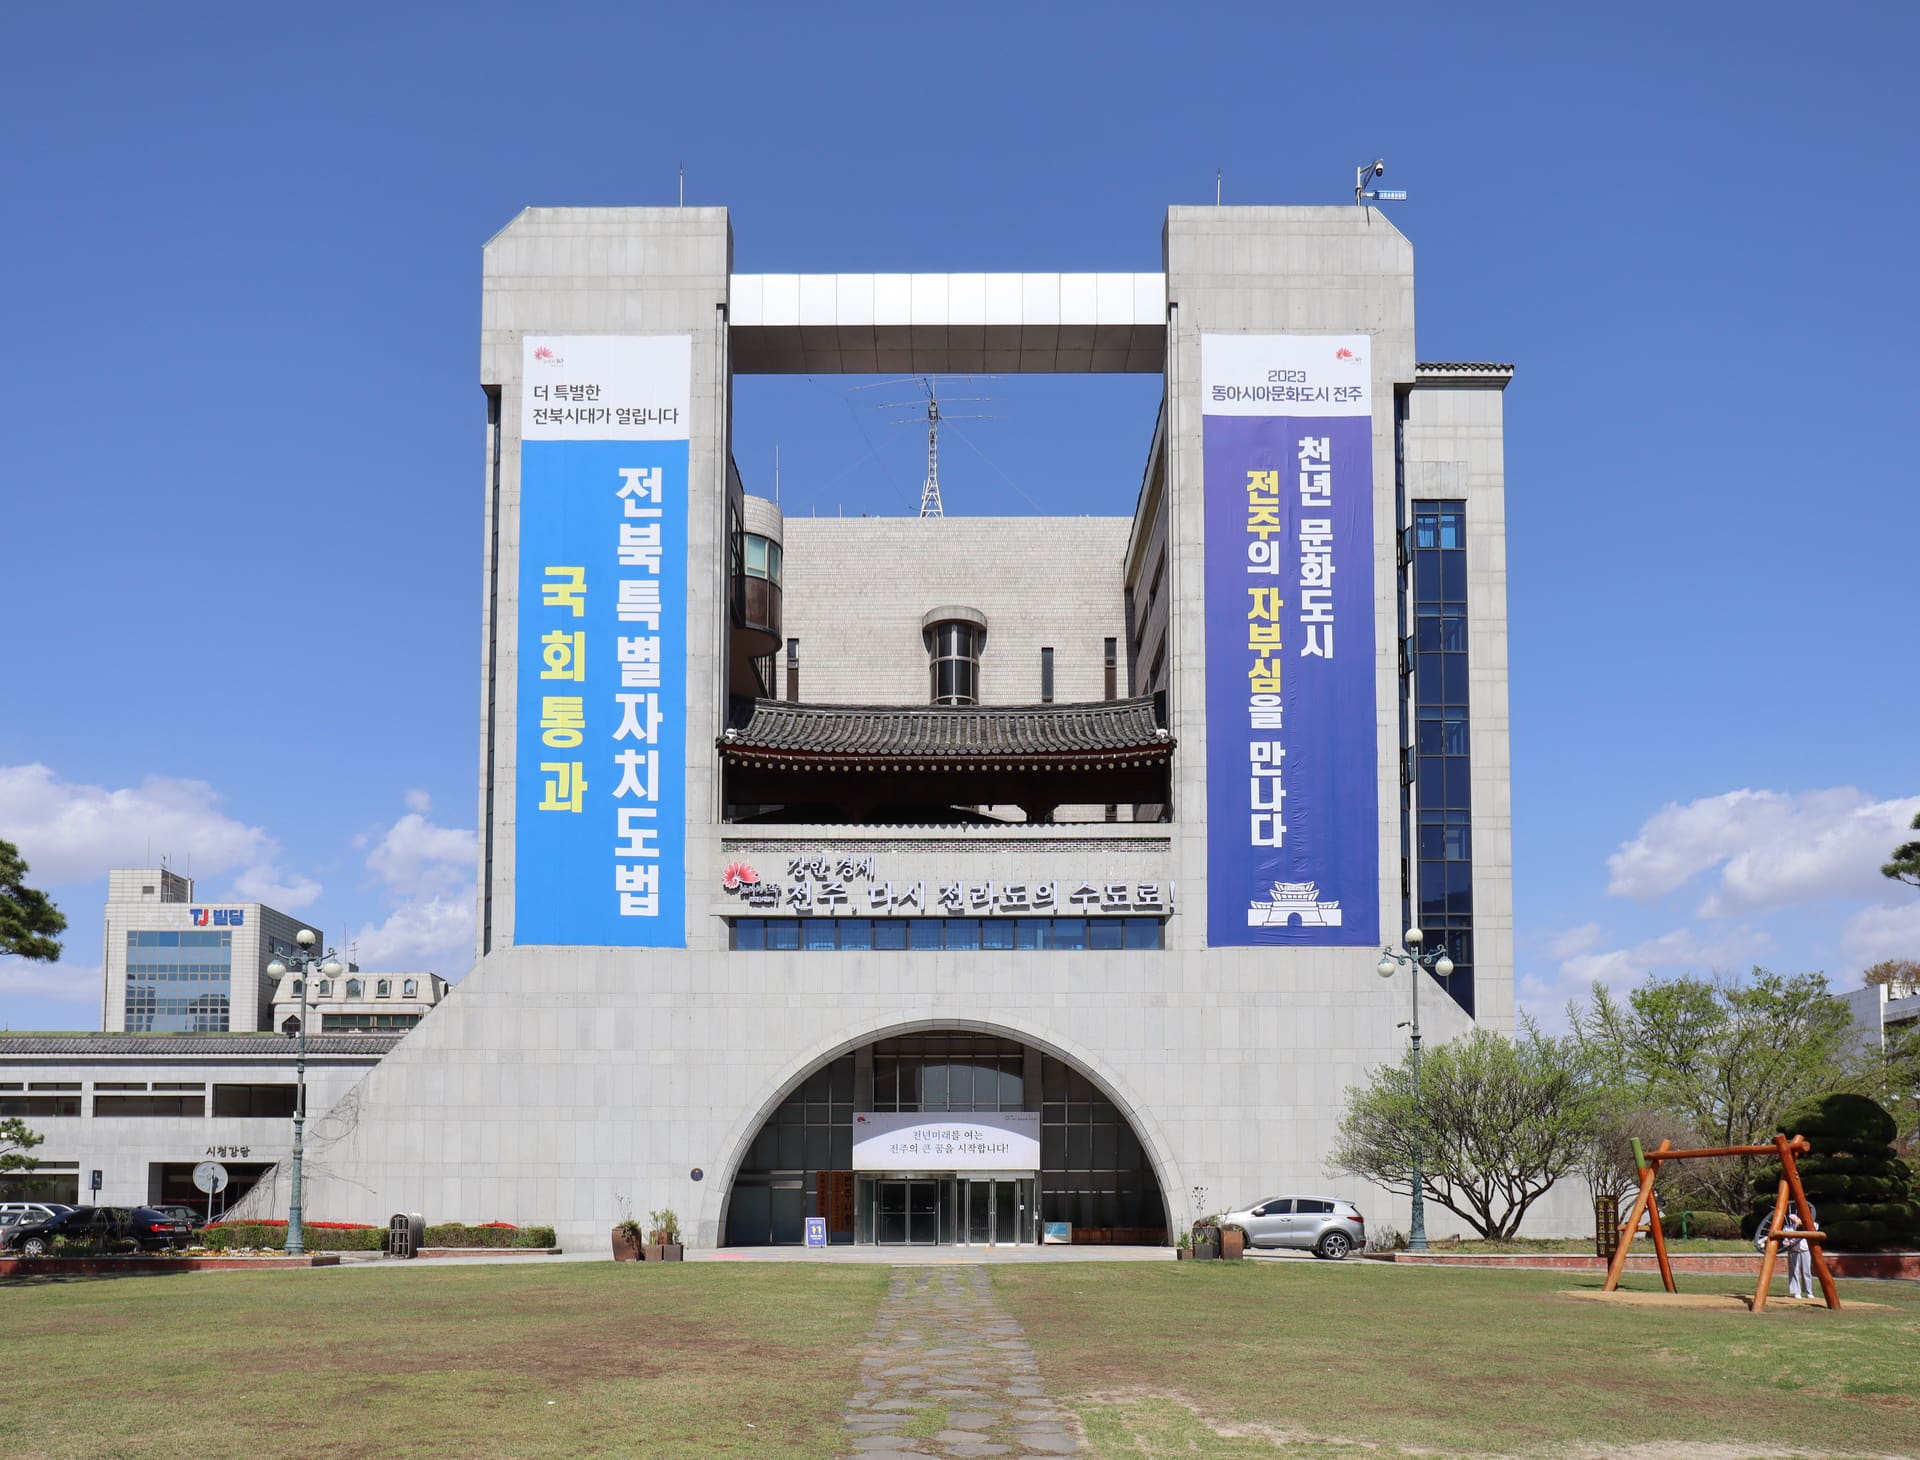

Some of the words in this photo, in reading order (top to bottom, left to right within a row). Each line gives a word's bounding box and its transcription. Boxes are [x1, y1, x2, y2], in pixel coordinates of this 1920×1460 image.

[1268, 370, 1306, 383] 2023
[533, 385, 549, 401] 더
[553, 384, 601, 401] 특별한
[1212, 385, 1329, 402] 동아시아문화도시
[1333, 386, 1363, 402] 전주
[533, 408, 611, 425] 전북시대가
[616, 408, 679, 425] 열립니다
[1298, 436, 1332, 507] 천년
[1247, 471, 1280, 575] 전주의
[1299, 519, 1336, 659] 문화도시
[1246, 587, 1284, 730] 자부심을
[612, 467, 663, 917] 전북특별자치도법
[1249, 741, 1287, 848] 만나다
[787, 856, 829, 880] 강한
[836, 856, 876, 881] 경제
[786, 880, 858, 913] 전주,
[869, 881, 927, 915] 다시
[939, 880, 1059, 912] 전라도의
[1069, 880, 1177, 913] 수도로!
[190, 909, 209, 926] TJ
[213, 909, 244, 926] 빌딩
[964, 1130, 983, 1141] 여는
[206, 1146, 250, 1157] 시청강당
[958, 1143, 1009, 1154] 시작합니다!
